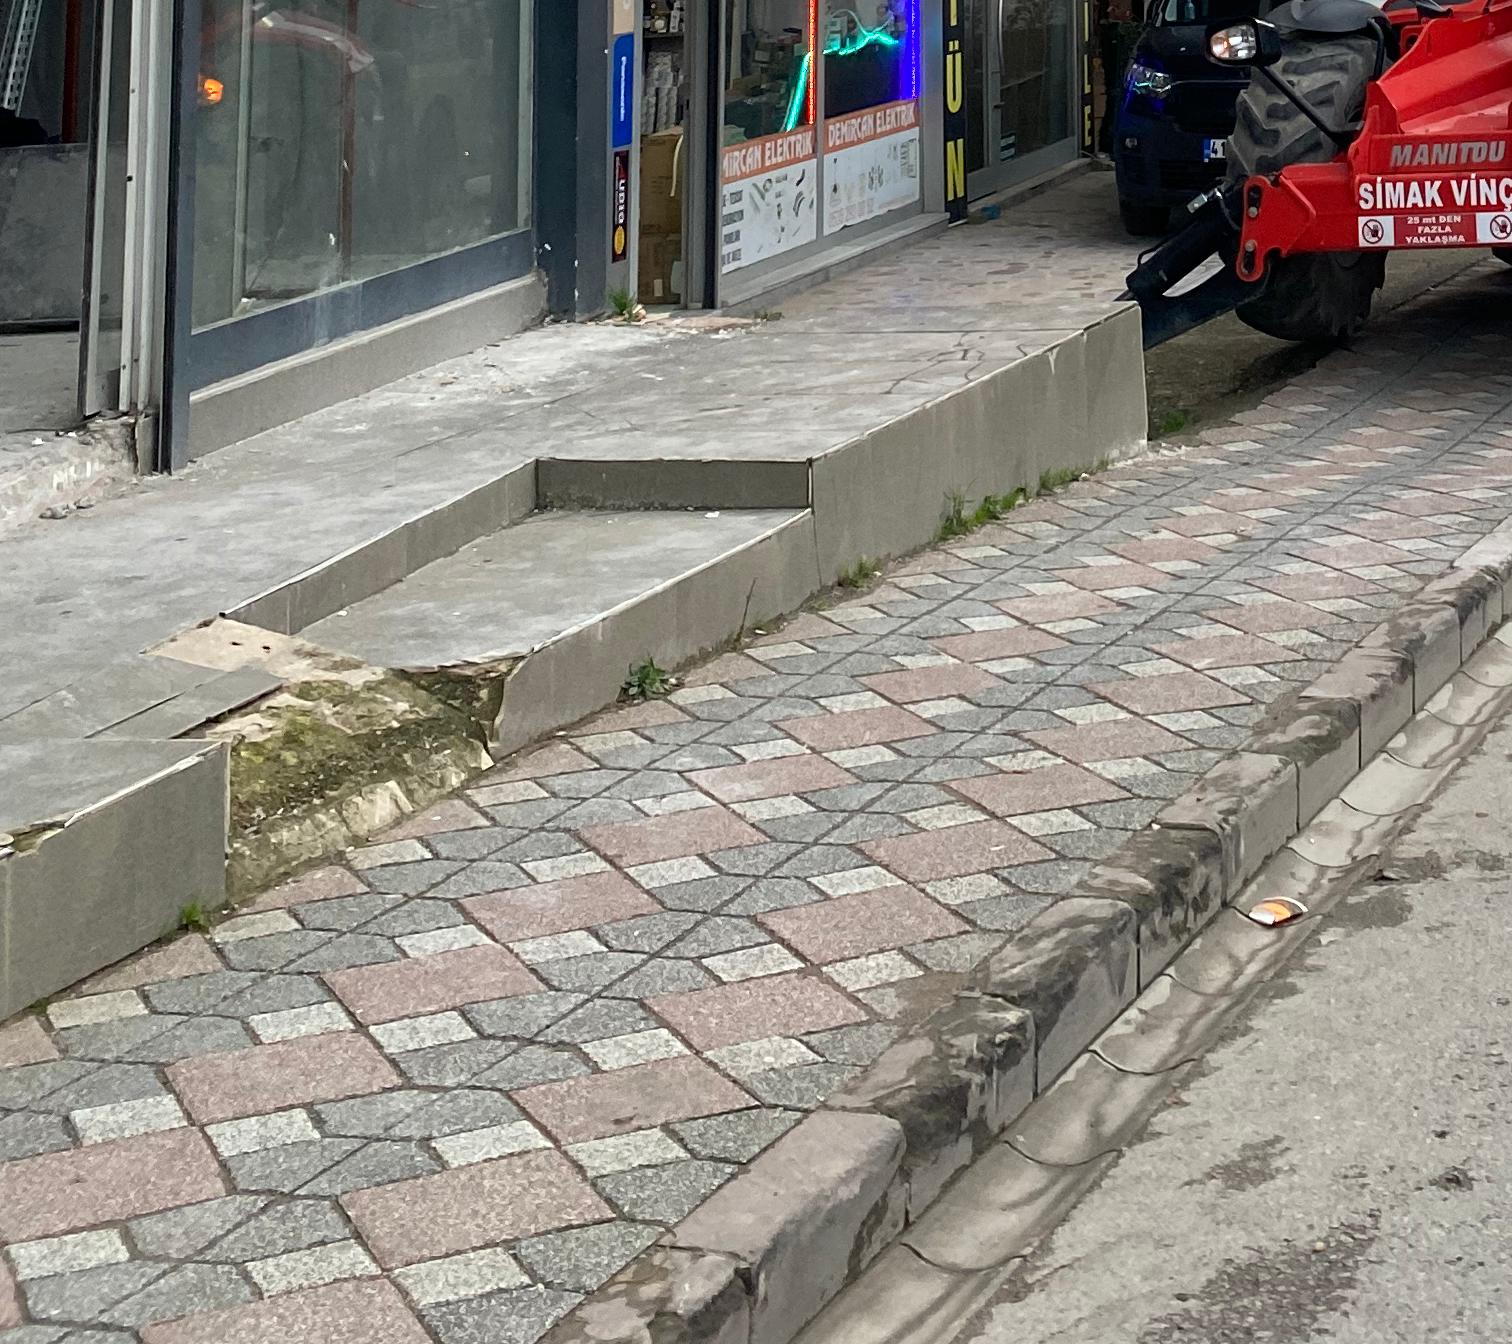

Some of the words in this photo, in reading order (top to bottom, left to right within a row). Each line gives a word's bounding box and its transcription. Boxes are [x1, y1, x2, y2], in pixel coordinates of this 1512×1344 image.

[1389, 140, 1506, 168] MANITOU
[1359, 176, 1444, 210] SİMAK
[1407, 216, 1420, 224] 25
[1439, 215, 1461, 223] DEN
[1418, 225, 1452, 234] FAZLA
[1405, 234, 1466, 245] YAKLAŞMA
